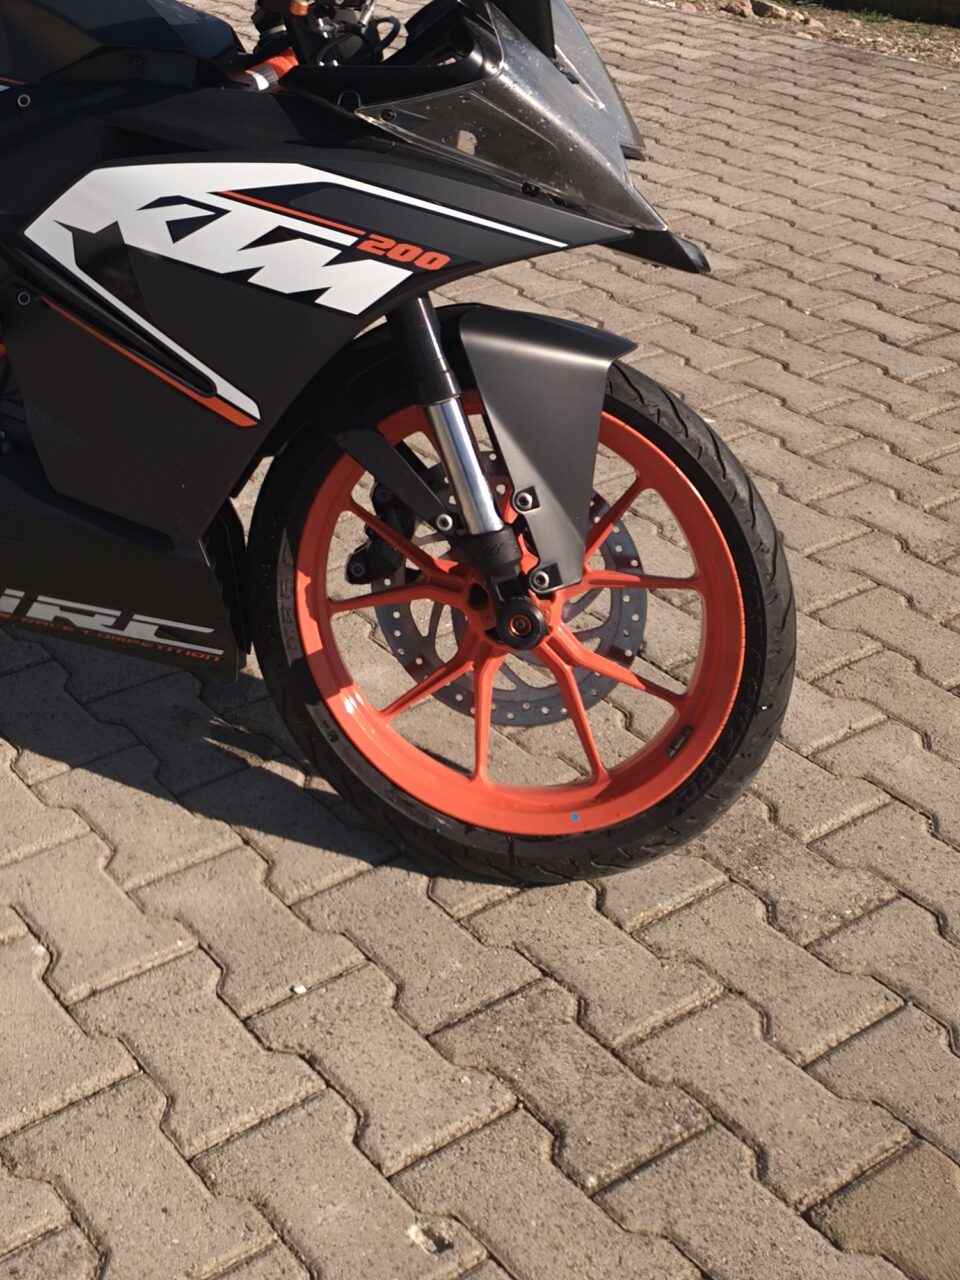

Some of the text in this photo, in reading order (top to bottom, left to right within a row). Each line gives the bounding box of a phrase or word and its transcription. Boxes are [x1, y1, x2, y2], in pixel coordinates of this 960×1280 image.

[52, 190, 452, 316] KTM 200
[83, 628, 221, 663] COMPETITION
